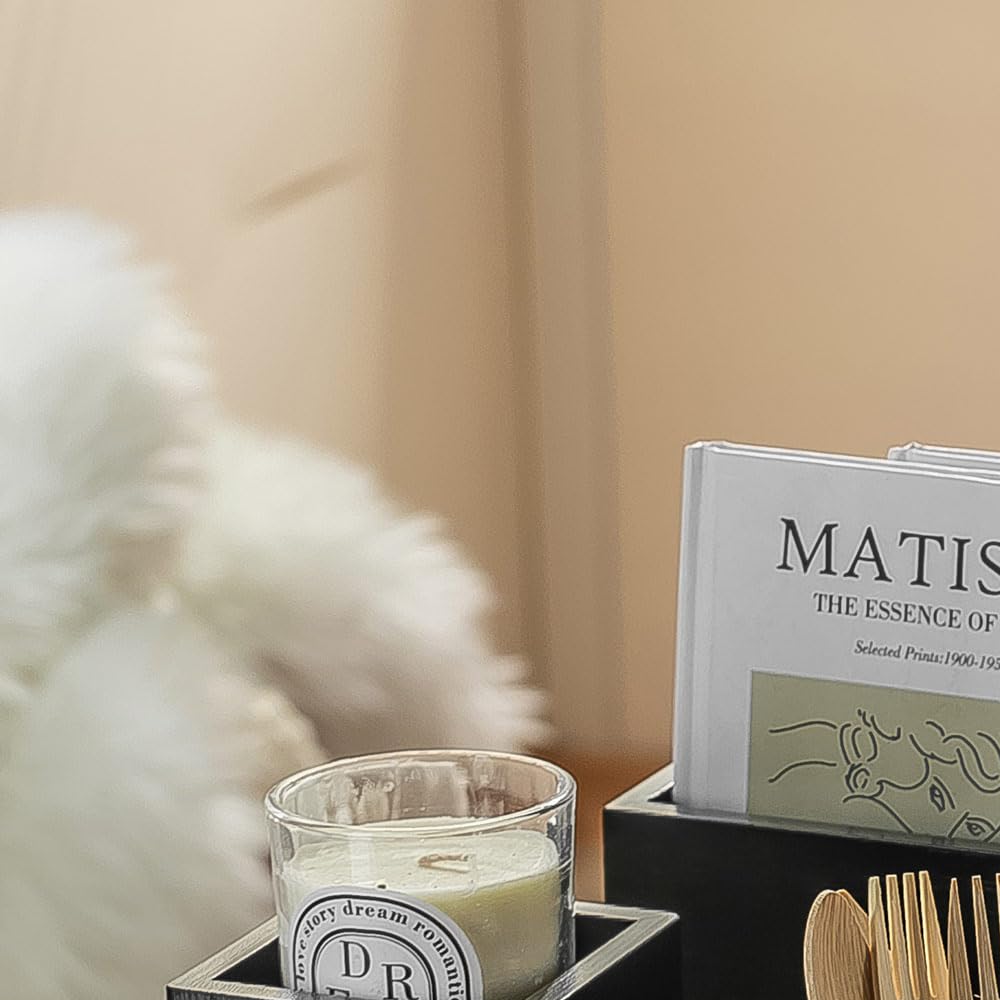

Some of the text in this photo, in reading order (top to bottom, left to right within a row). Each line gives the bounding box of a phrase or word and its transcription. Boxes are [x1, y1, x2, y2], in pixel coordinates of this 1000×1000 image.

[813, 592, 858, 617] THE
[865, 599, 961, 629] ESSENCE
[968, 611, 998, 633] OF
[854, 639, 901, 659] Selected
[342, 900, 408, 926] dream
